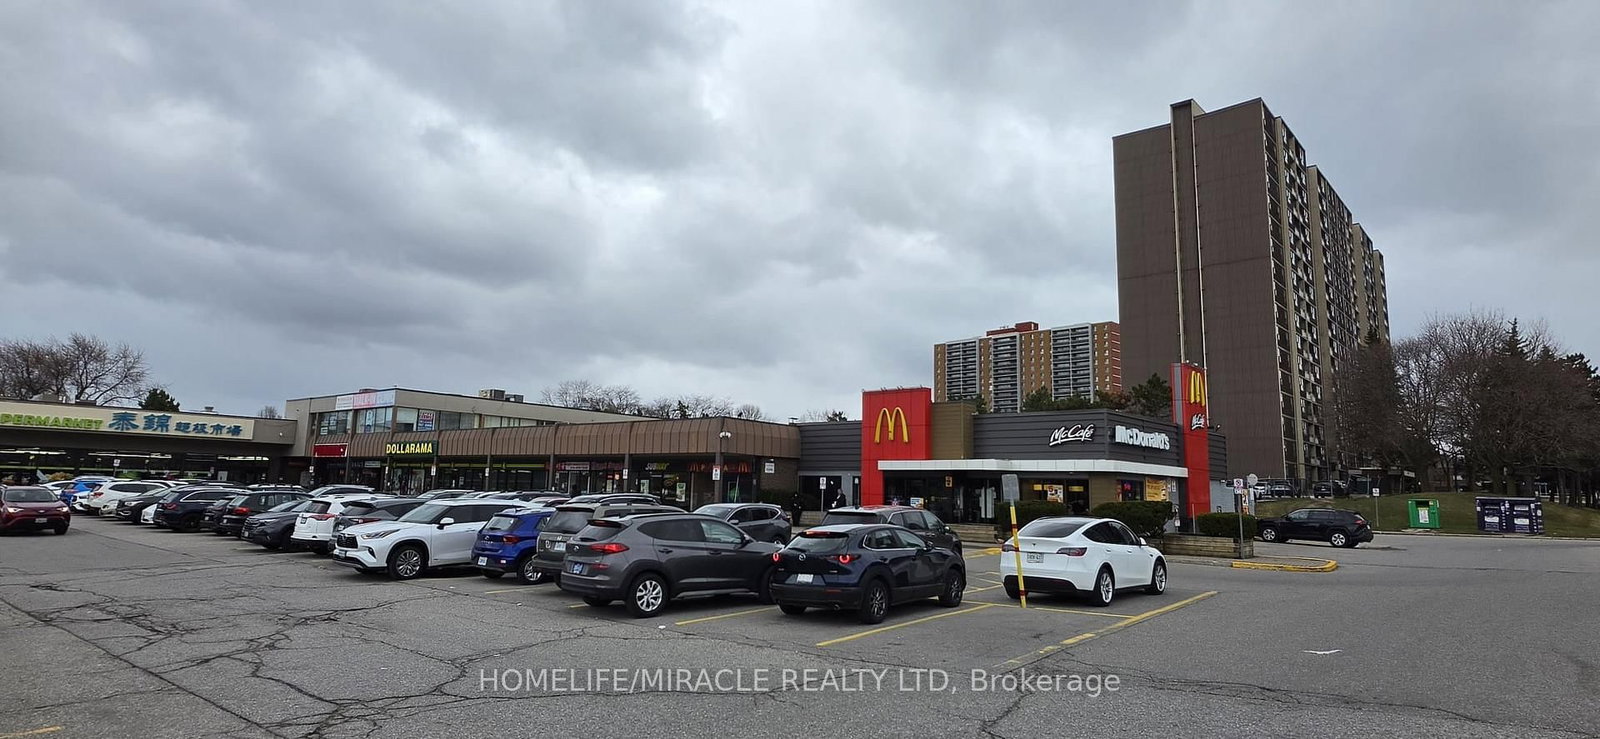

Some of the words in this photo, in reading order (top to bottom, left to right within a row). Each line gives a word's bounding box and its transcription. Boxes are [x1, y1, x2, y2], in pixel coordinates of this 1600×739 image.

[0, 413, 103, 429] PERMARKET
[1115, 425, 1170, 450] McDonald's
[386, 442, 433, 454] DOLLARAMA
